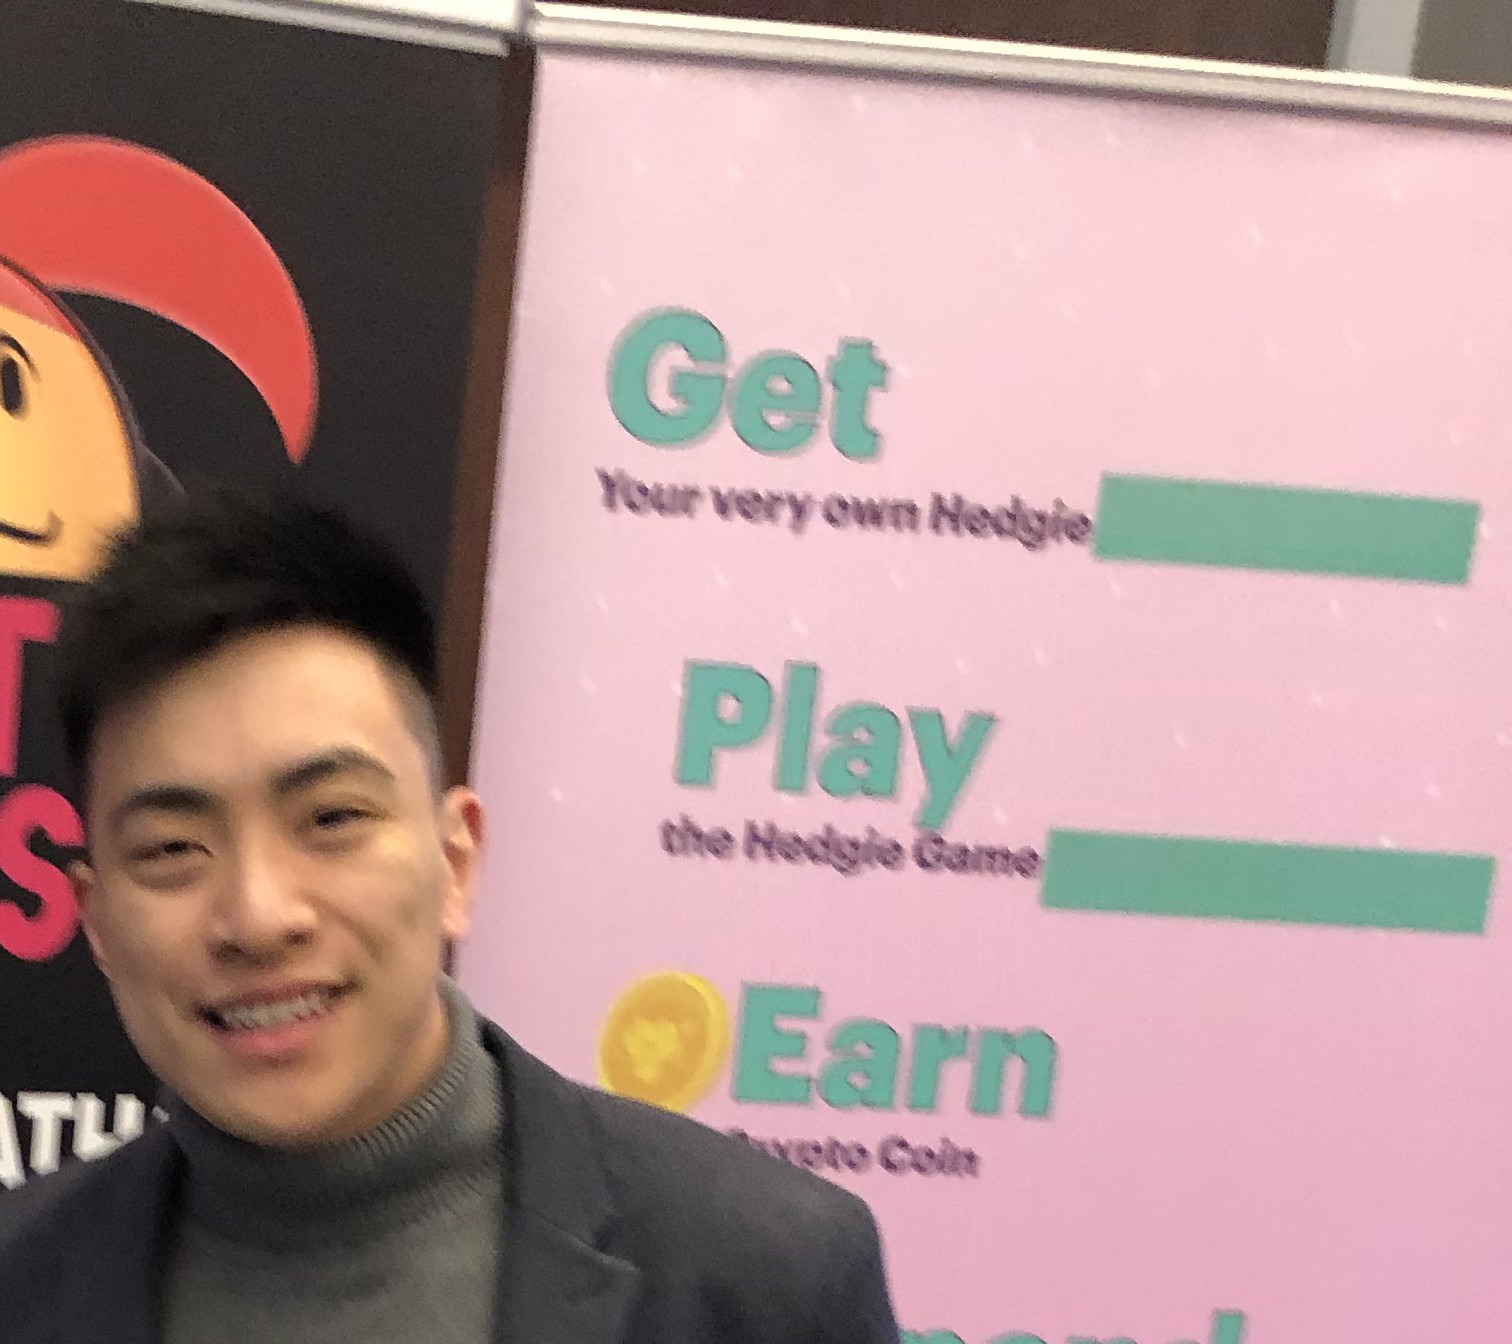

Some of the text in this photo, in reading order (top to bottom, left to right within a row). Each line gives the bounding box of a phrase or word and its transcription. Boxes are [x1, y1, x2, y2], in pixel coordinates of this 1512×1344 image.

[606, 305, 889, 462] Get
[594, 466, 1092, 551] Your very own Hedgie
[674, 660, 996, 830] Play
[659, 813, 1042, 879] the Hedgie Game
[732, 981, 1058, 1118] Earn
[878, 1134, 981, 1179] Coin
